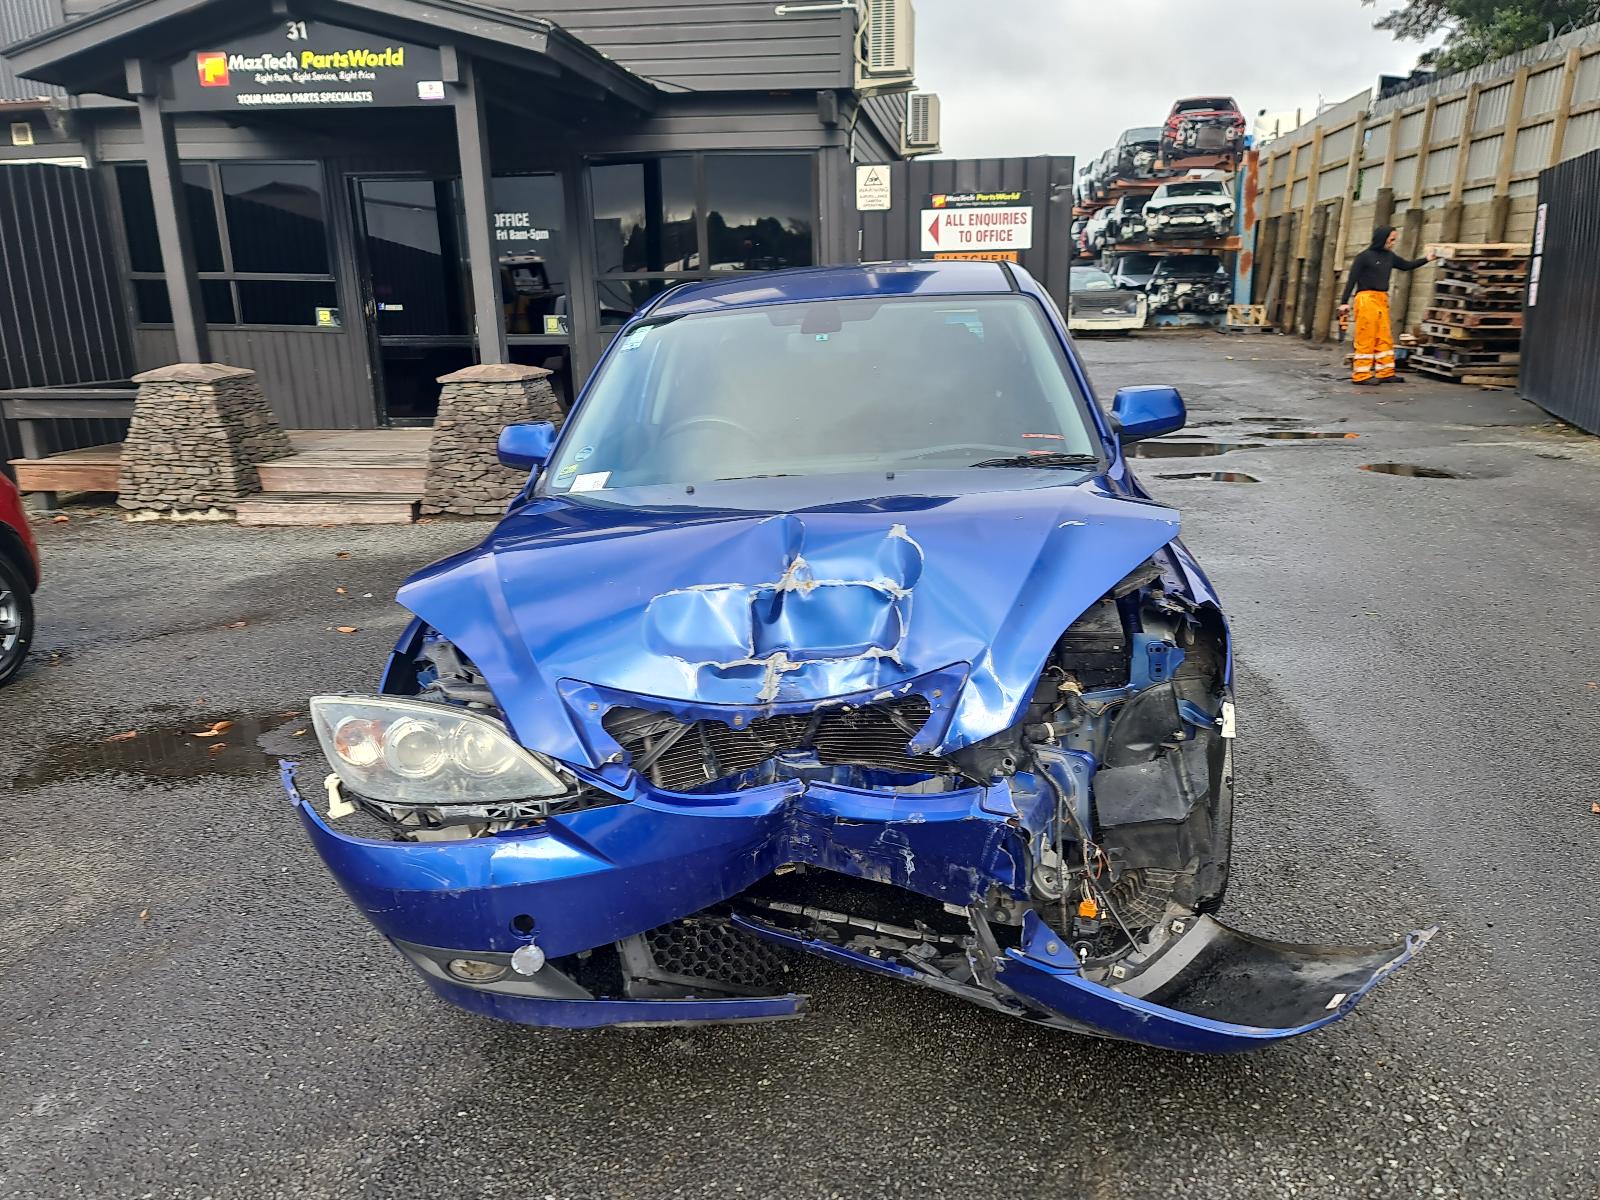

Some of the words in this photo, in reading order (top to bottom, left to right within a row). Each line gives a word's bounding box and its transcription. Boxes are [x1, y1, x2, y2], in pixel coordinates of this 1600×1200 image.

[286, 21, 308, 41] 31
[228, 51, 298, 71] MazTech
[301, 47, 404, 69] PartsWorld
[237, 94, 261, 105] YOUR
[262, 93, 292, 104] MAZDA
[292, 92, 319, 103] PARTS
[320, 91, 373, 103] SPECIALISTS
[945, 214, 965, 227] ALL
[969, 212, 1028, 226] ENQUIRIES
[496, 229, 508, 240] Fri
[959, 230, 972, 243] TO
[976, 229, 1014, 242] OFFICE
